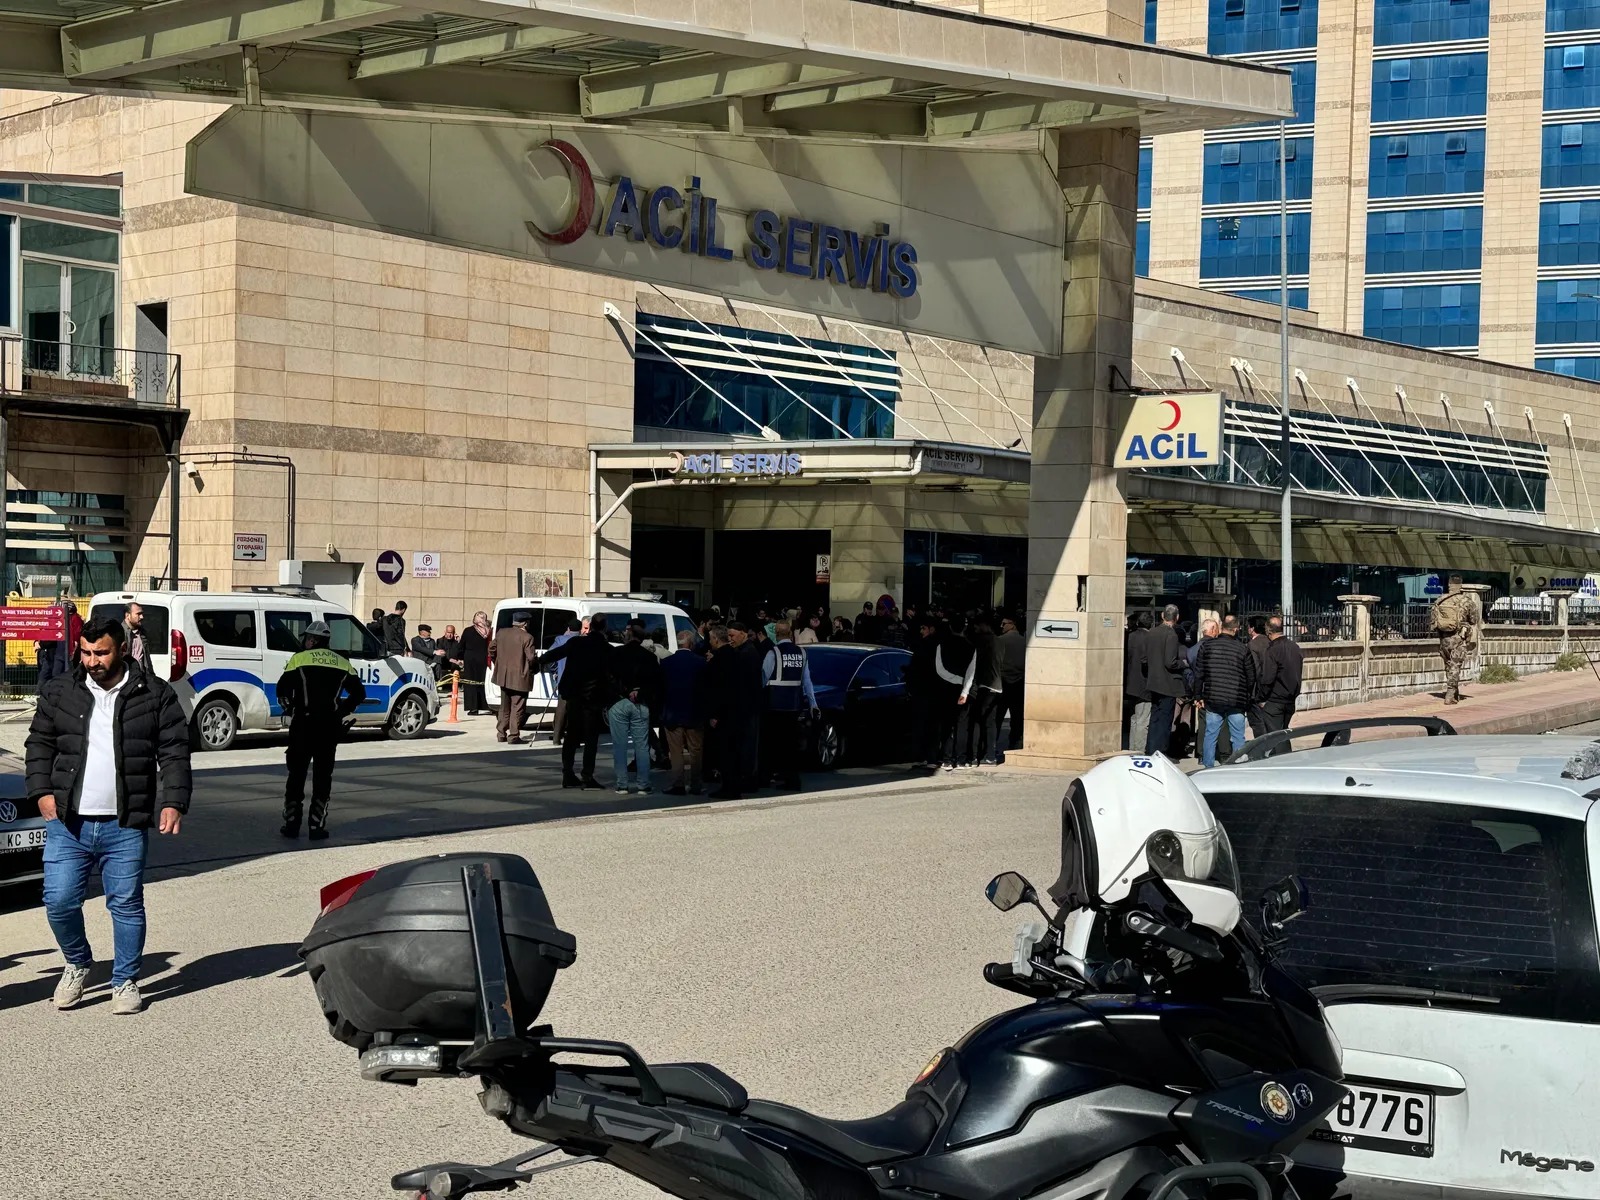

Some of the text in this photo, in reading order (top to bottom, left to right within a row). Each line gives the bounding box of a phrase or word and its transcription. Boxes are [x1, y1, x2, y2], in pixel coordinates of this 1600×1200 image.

[598, 175, 918, 298] ACİL SERVİS
[191, 646, 203, 656] 112
[782, 653, 803, 661] BASIN
[782, 660, 803, 668] PRESS
[361, 664, 380, 684] LİS
[8, 834, 21, 847] KC
[1337, 1090, 1424, 1136] 8776
[1500, 1148, 1595, 1173] Mégane
